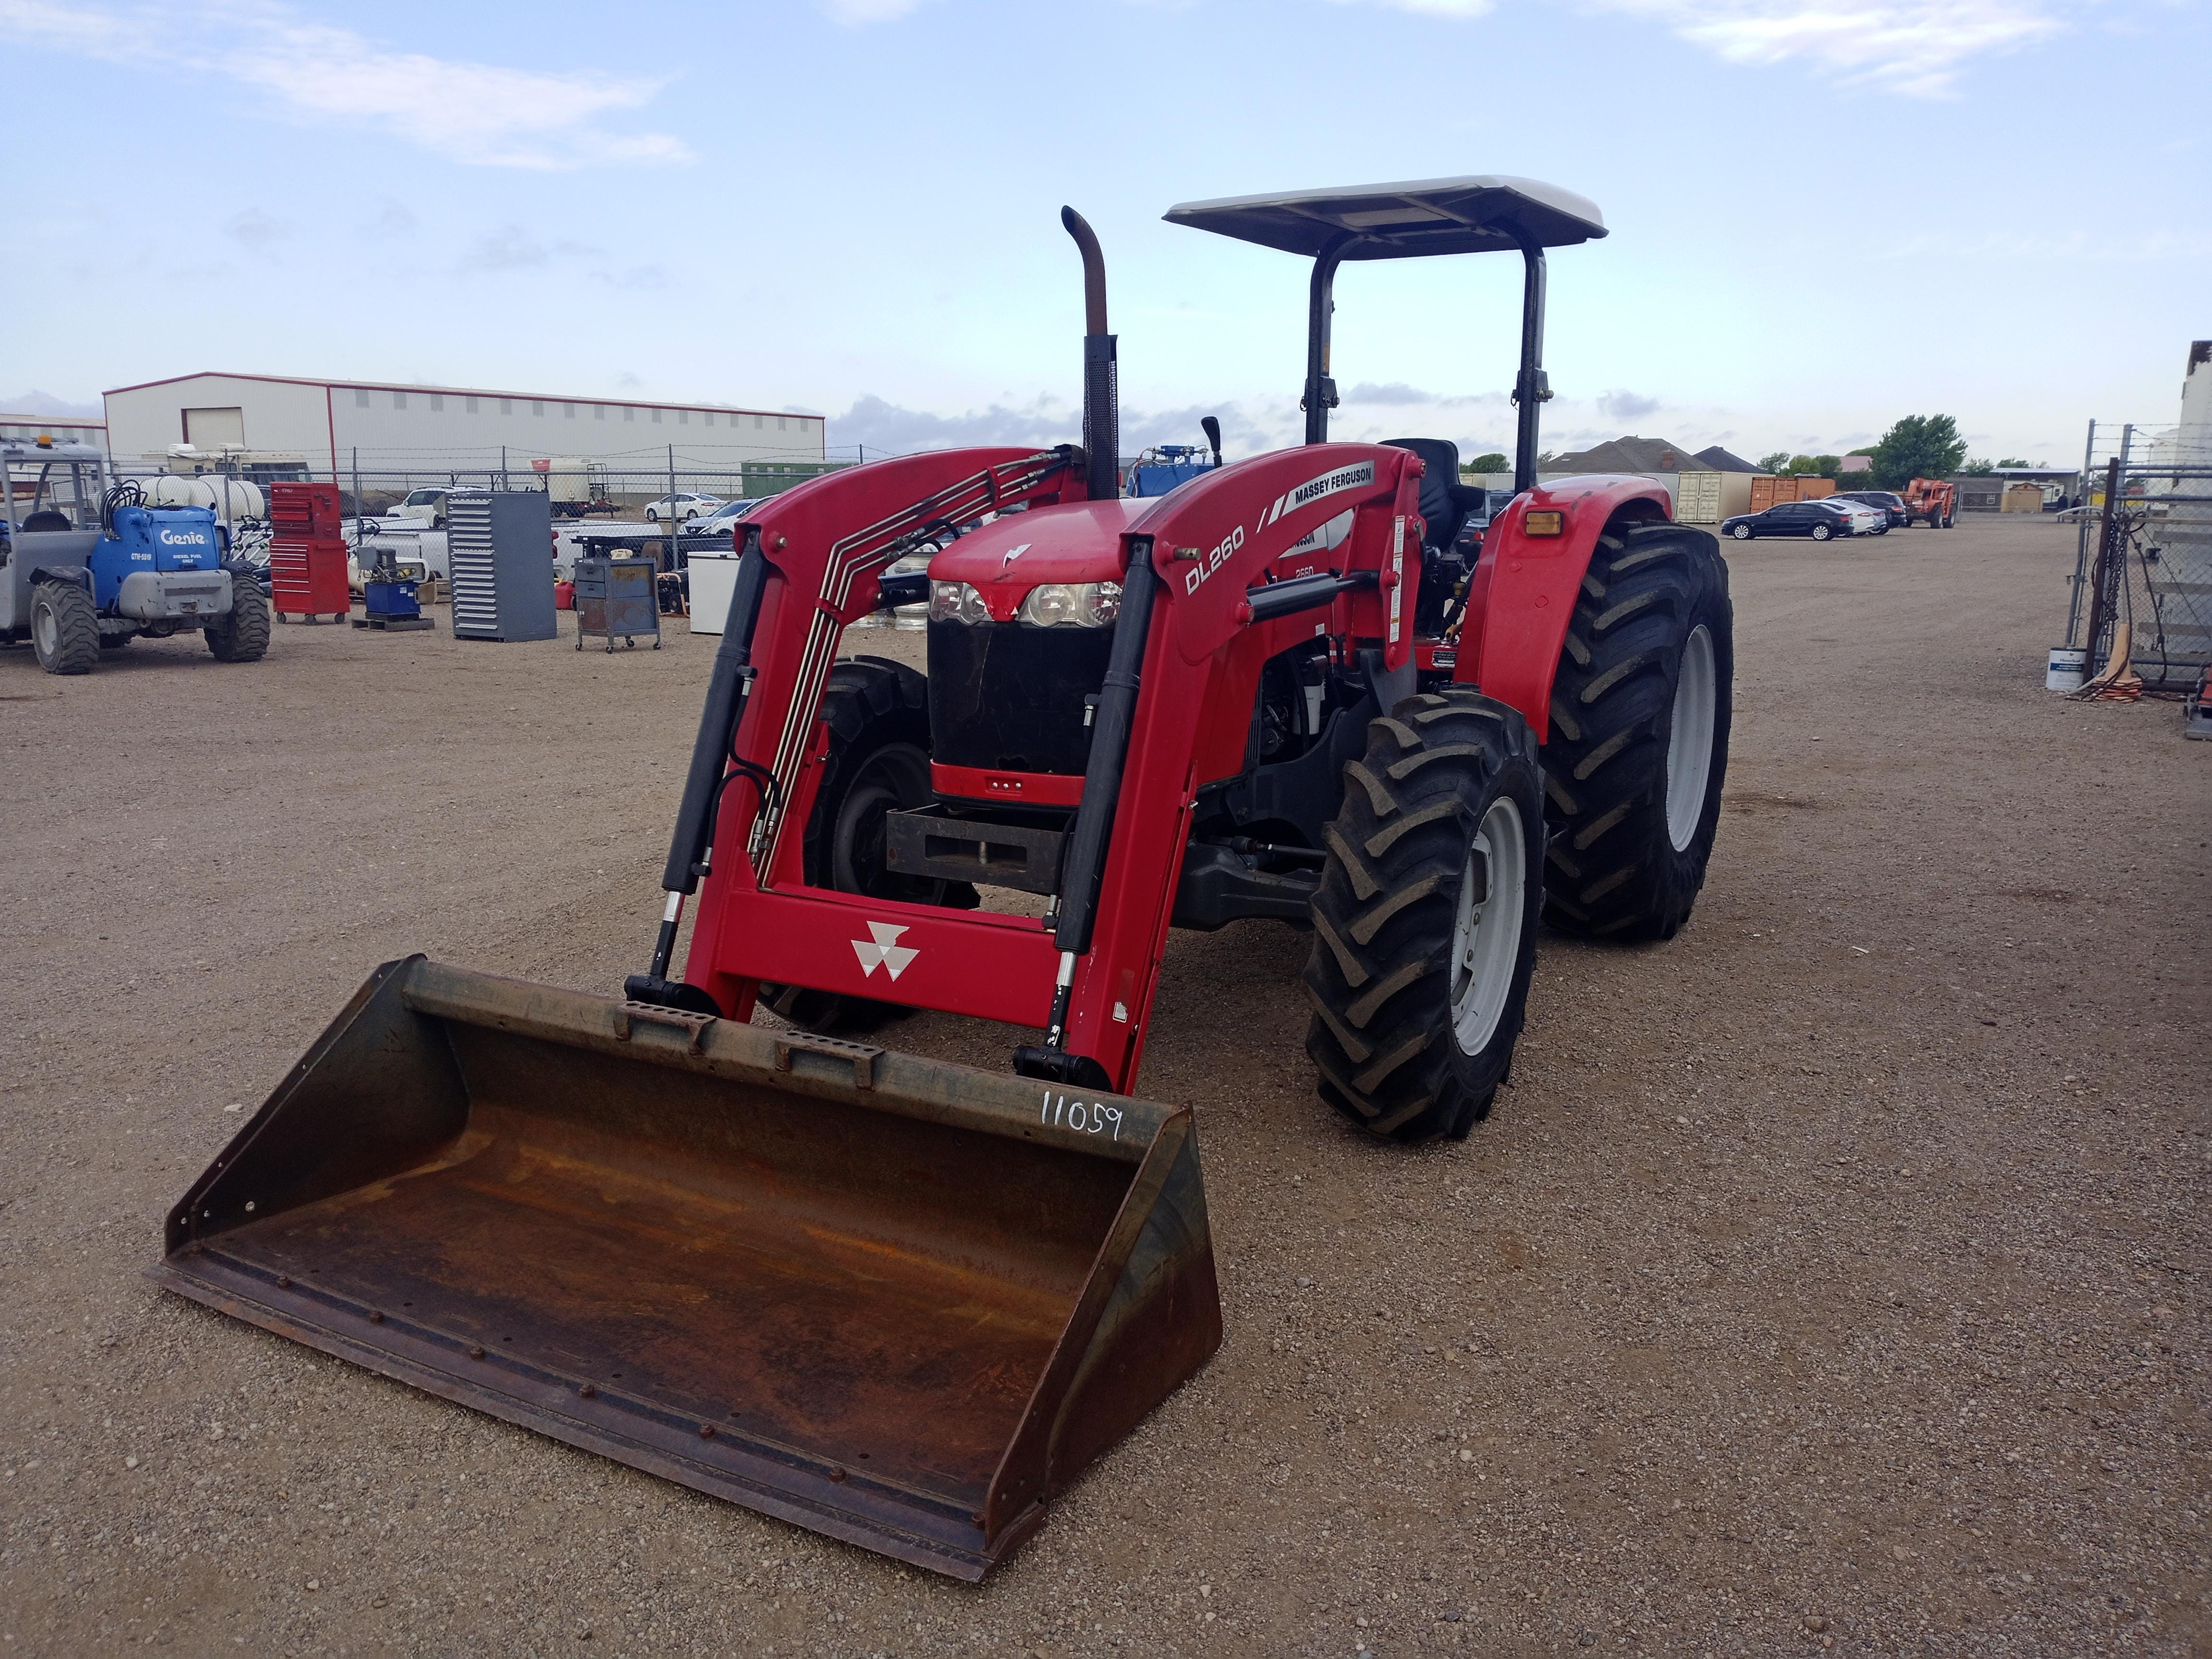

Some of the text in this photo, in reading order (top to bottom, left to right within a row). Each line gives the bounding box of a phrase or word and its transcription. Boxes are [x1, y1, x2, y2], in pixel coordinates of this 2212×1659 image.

[1296, 468, 1371, 504] MASSEY FERGUSON
[161, 529, 205, 545] Genie
[1185, 525, 1244, 596] DL260
[1296, 566, 1313, 578] 2660
[1042, 1091, 1122, 1141] 11059
